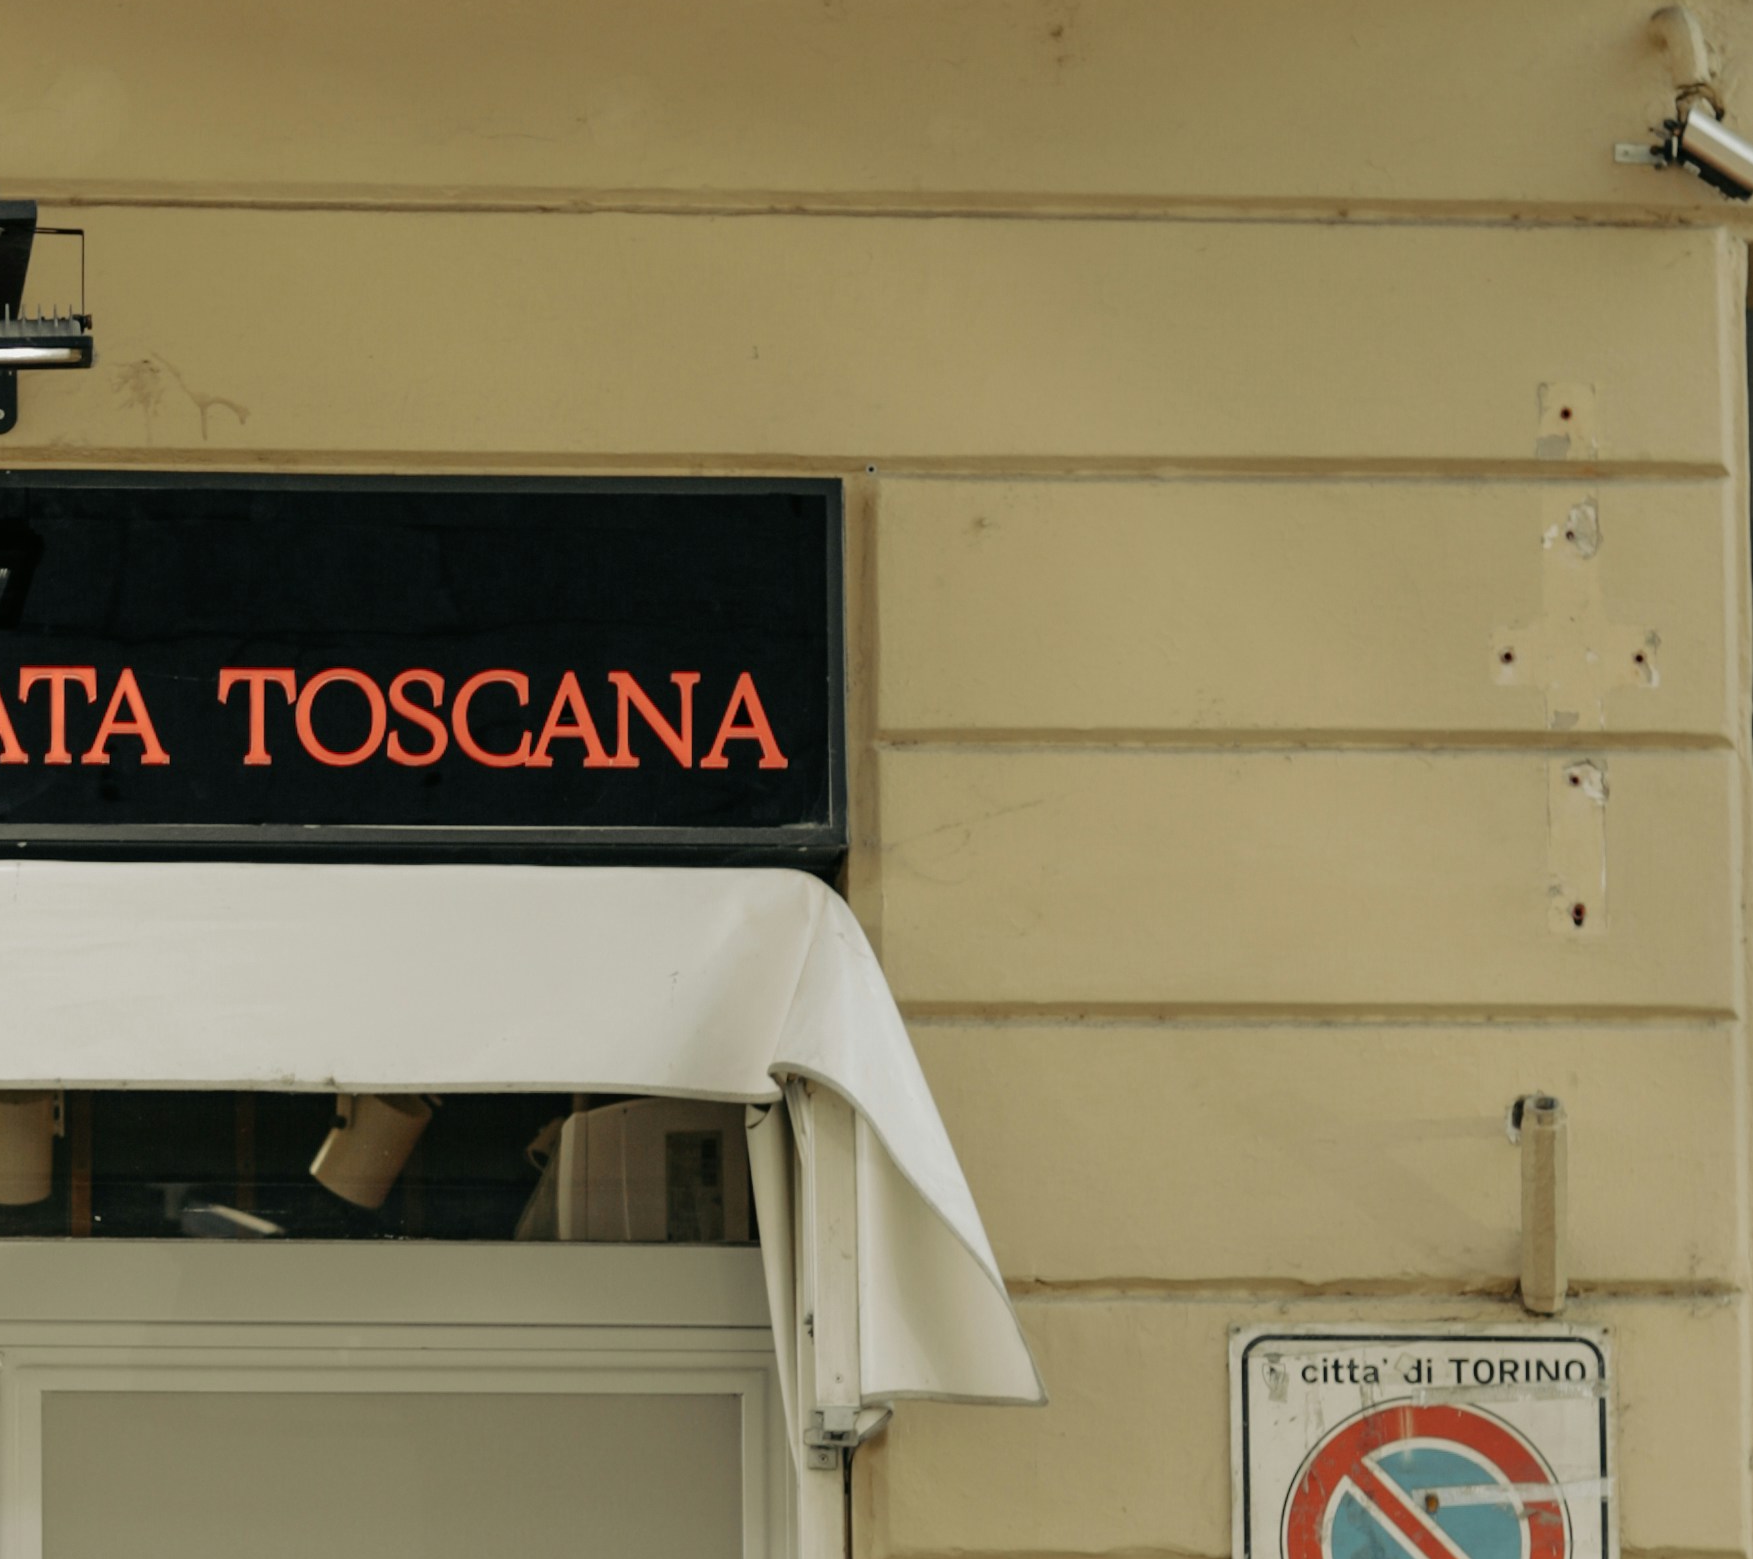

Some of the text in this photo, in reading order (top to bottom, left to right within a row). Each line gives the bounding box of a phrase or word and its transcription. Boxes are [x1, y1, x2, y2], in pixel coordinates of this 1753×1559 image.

[218, 667, 789, 771] TOSCANA
[1403, 1359, 1433, 1385] di
[1452, 1359, 1588, 1385] TORINO
